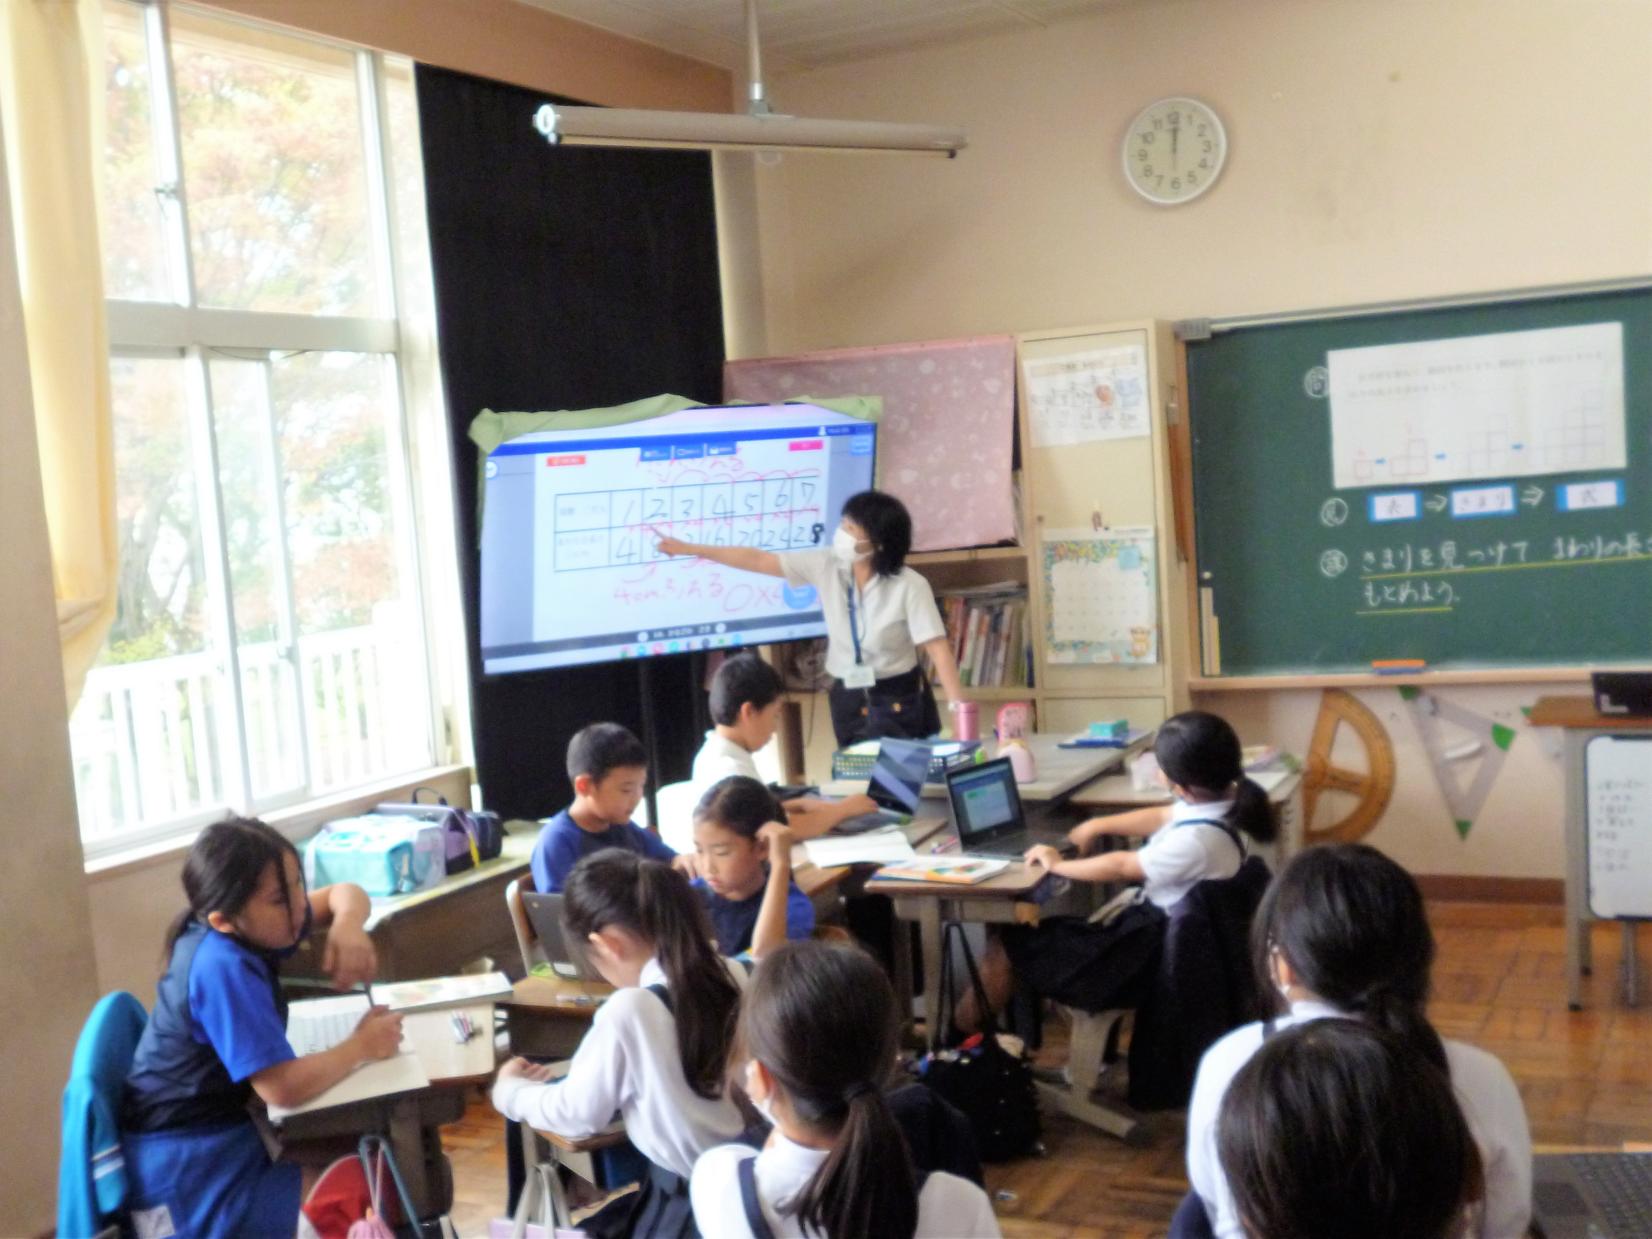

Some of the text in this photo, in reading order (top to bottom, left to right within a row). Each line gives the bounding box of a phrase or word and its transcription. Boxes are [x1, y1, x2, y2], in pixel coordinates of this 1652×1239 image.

[643, 498, 667, 520] 2
[680, 499, 694, 518] 3
[712, 494, 736, 515] 4
[744, 494, 760, 511] 5
[775, 479, 788, 508] 6
[801, 482, 815, 502] 7
[616, 535, 637, 563] 4
[1363, 541, 1529, 573] きまりを見つけて
